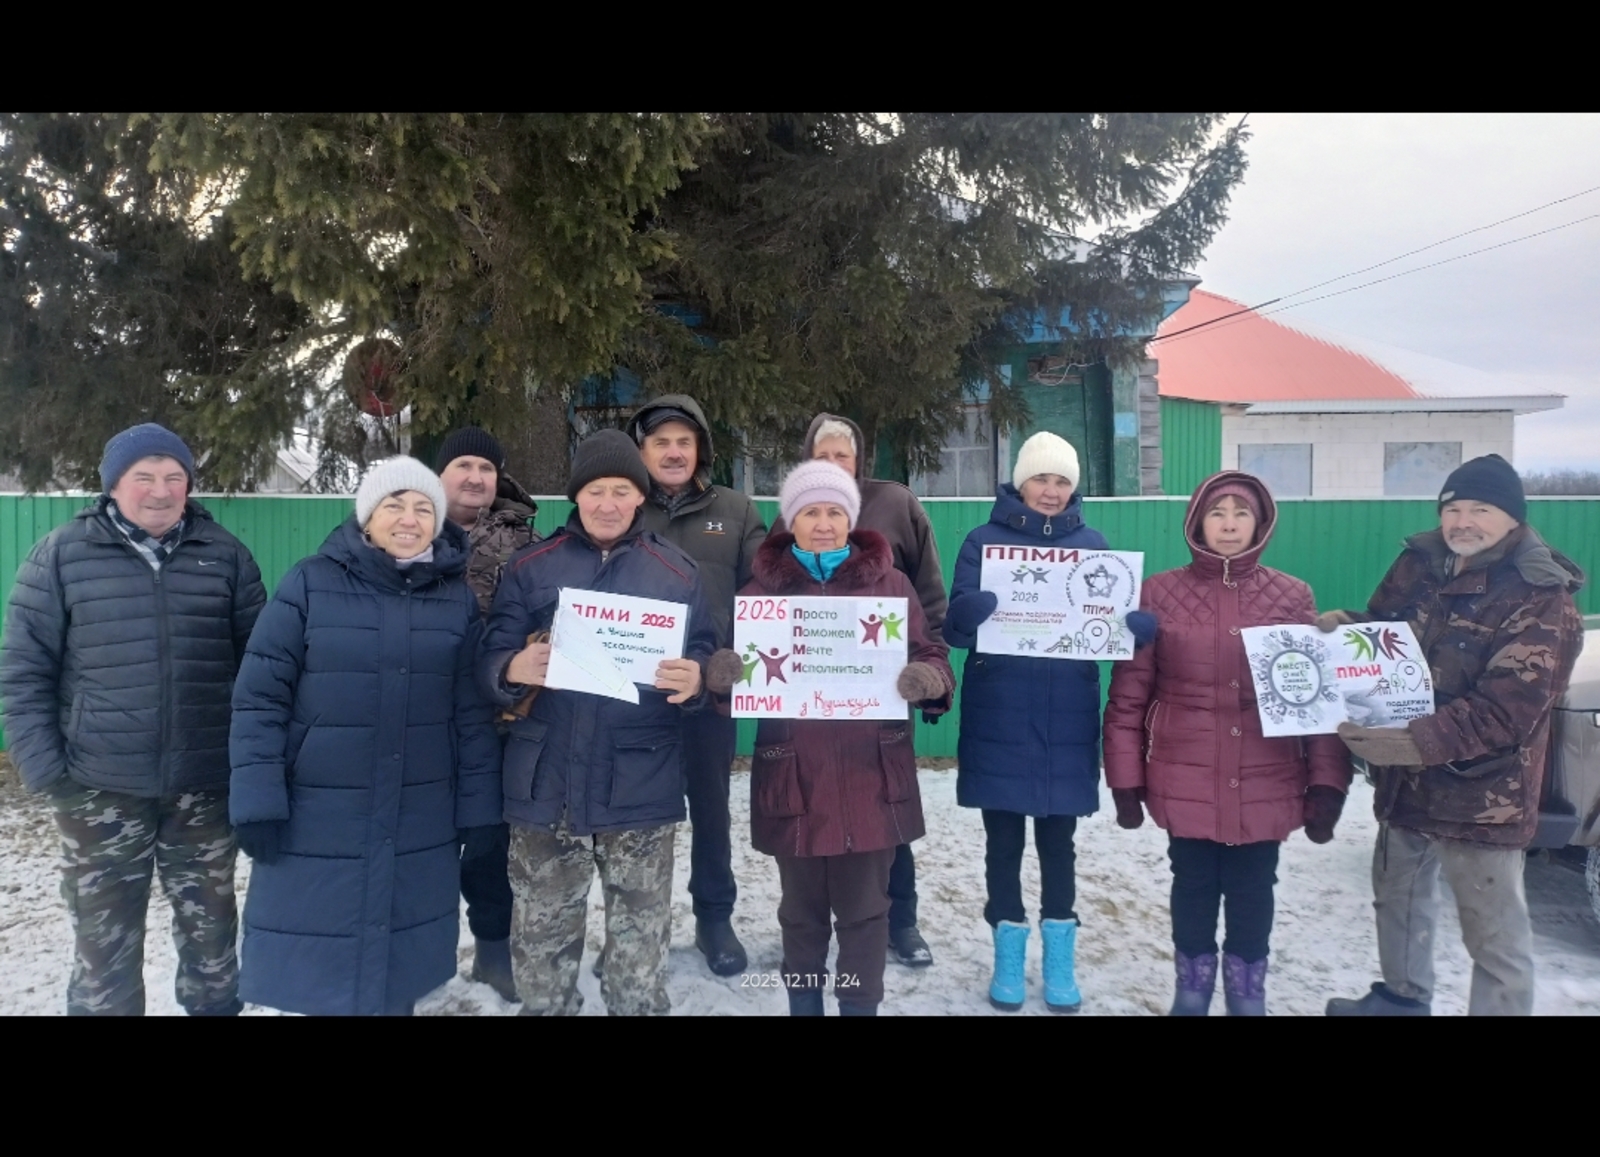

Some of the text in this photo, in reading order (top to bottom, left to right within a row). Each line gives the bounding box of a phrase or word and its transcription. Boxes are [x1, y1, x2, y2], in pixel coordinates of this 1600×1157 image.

[985, 547, 1079, 563] ППМИ
[1011, 591, 1039, 603] 2026
[736, 599, 788, 621] 2026
[793, 608, 838, 622] Просто
[640, 613, 676, 629] 2025
[793, 626, 856, 639] Поможем
[792, 644, 833, 656] Мечте
[792, 662, 873, 674] Исполниться
[1277, 661, 1311, 671] ВМЕСТЕ
[1336, 664, 1382, 678] ППМИ
[735, 695, 782, 712] ППМИ
